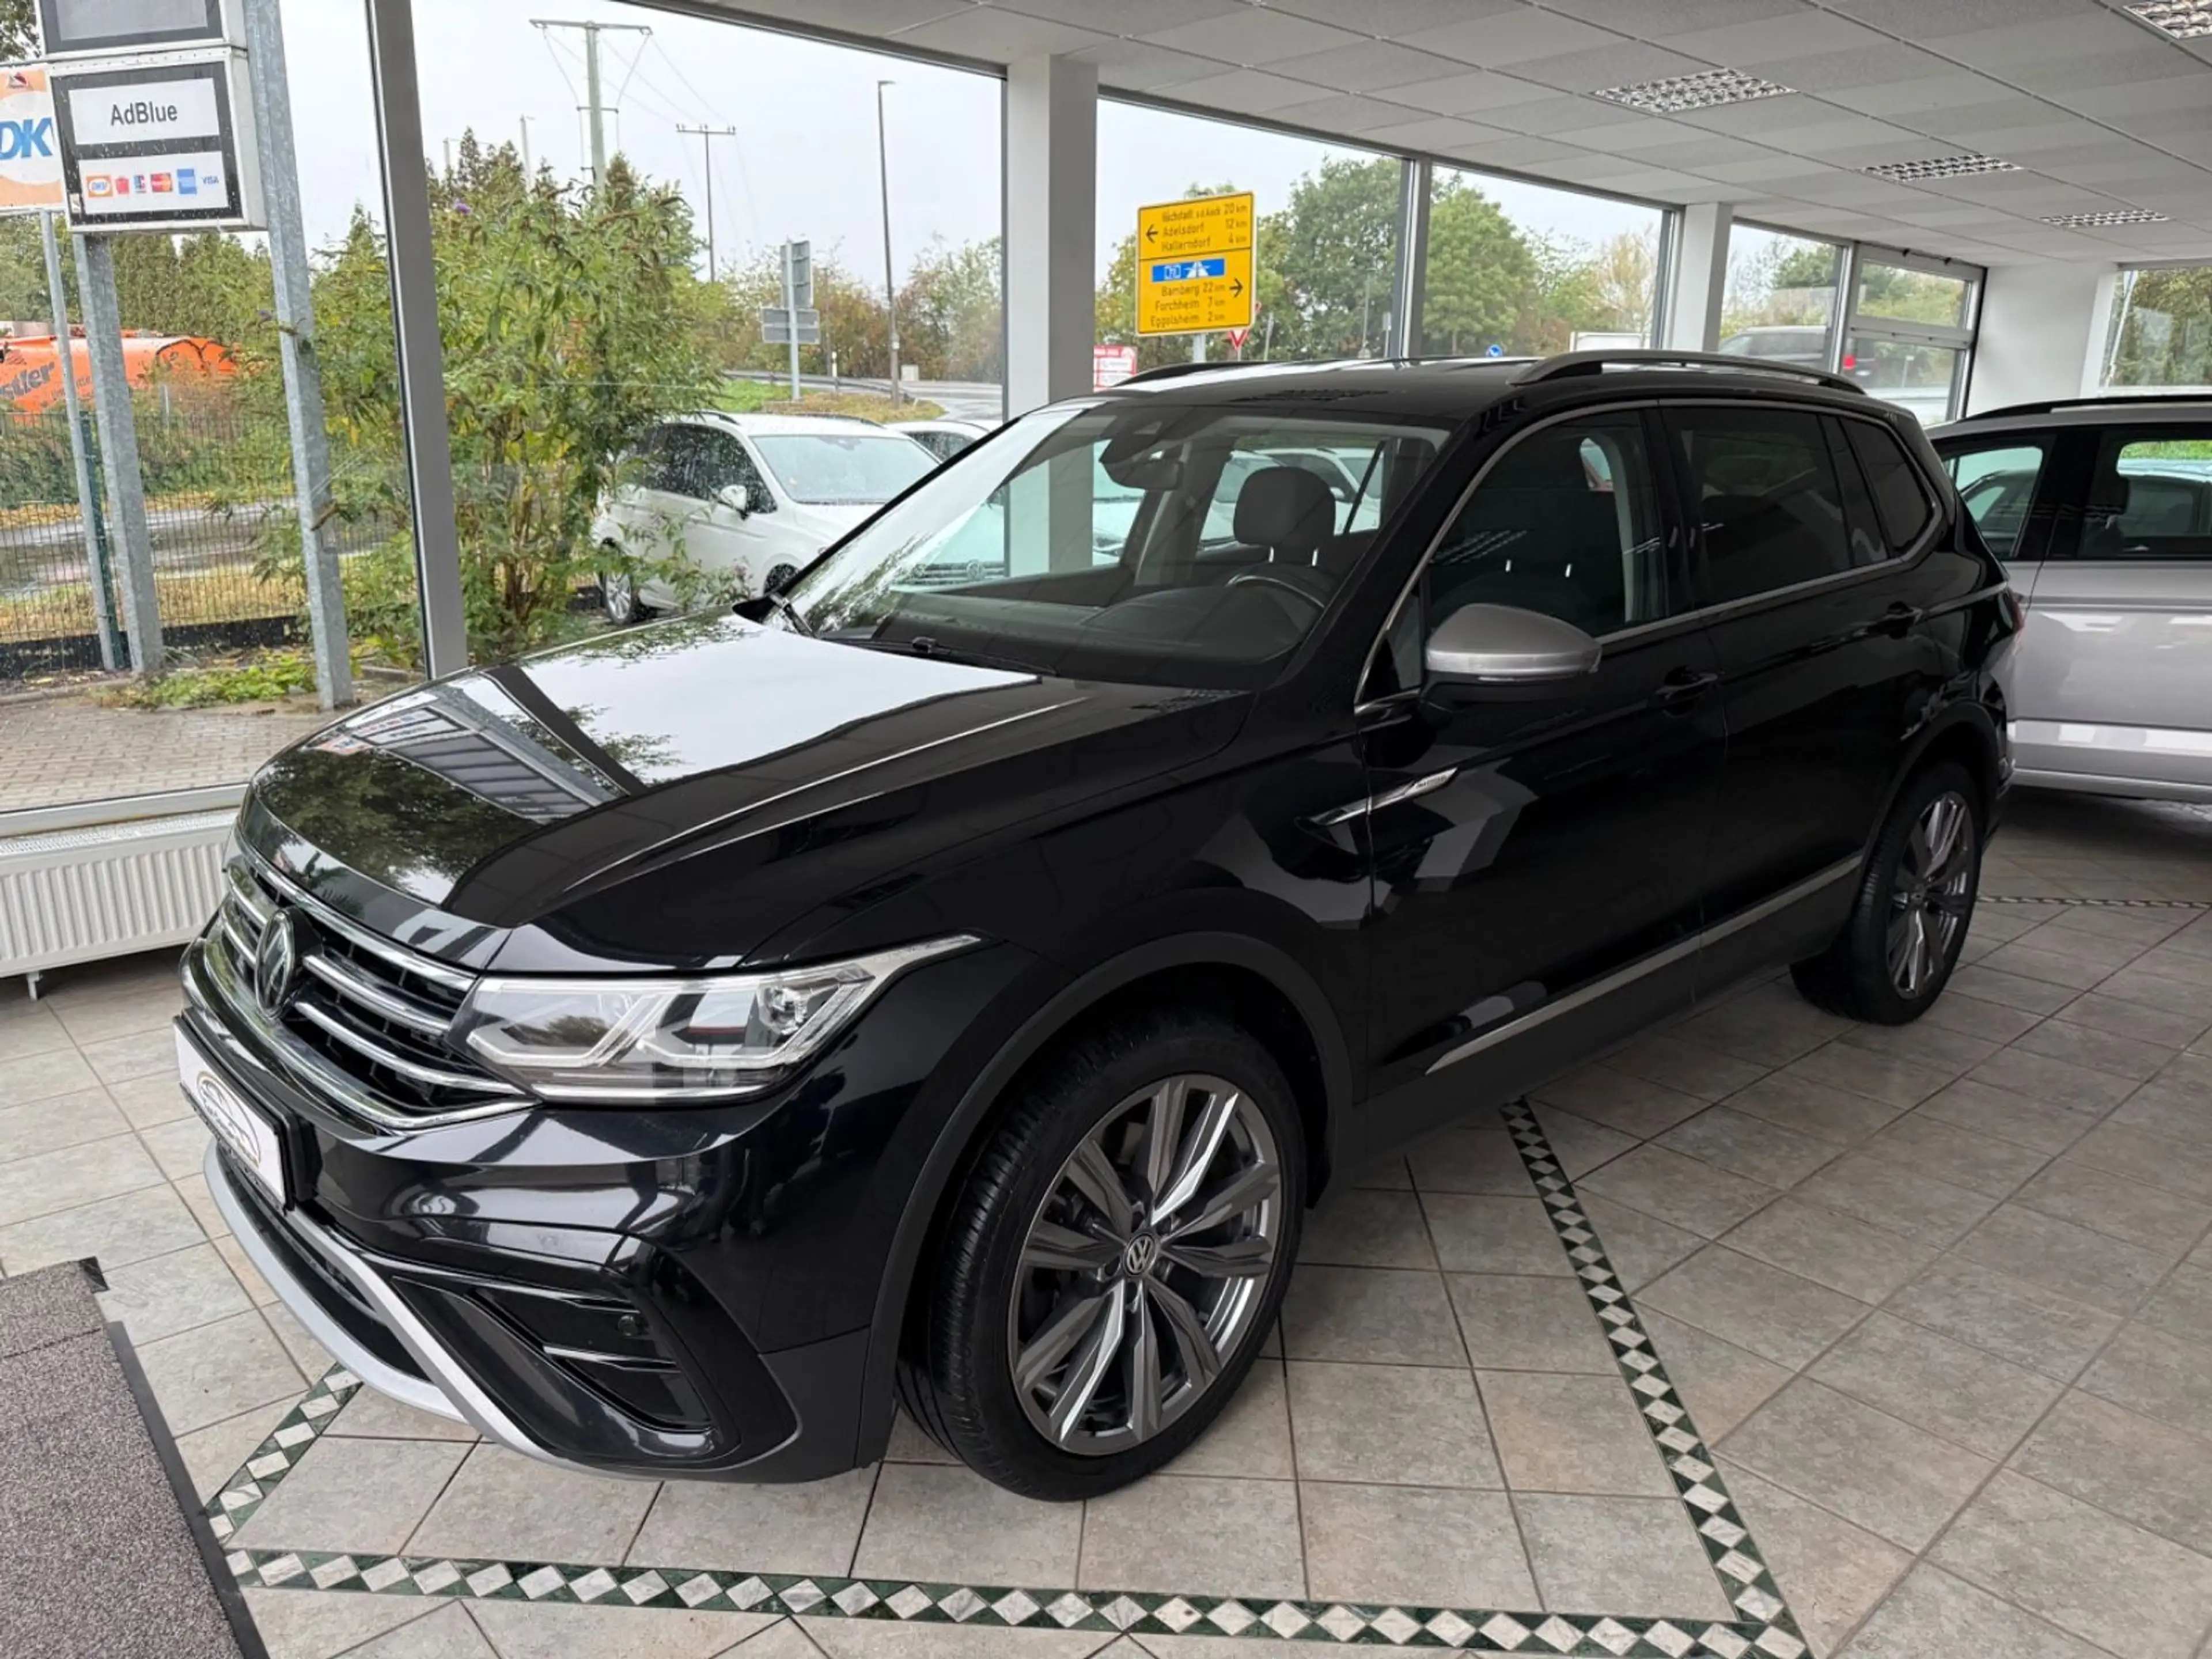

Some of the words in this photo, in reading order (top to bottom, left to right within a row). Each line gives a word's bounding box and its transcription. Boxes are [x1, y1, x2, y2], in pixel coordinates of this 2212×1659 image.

[110, 101, 178, 126] AdBlue
[1161, 285, 1200, 297] Bamberg
[1203, 281, 1214, 293] 22
